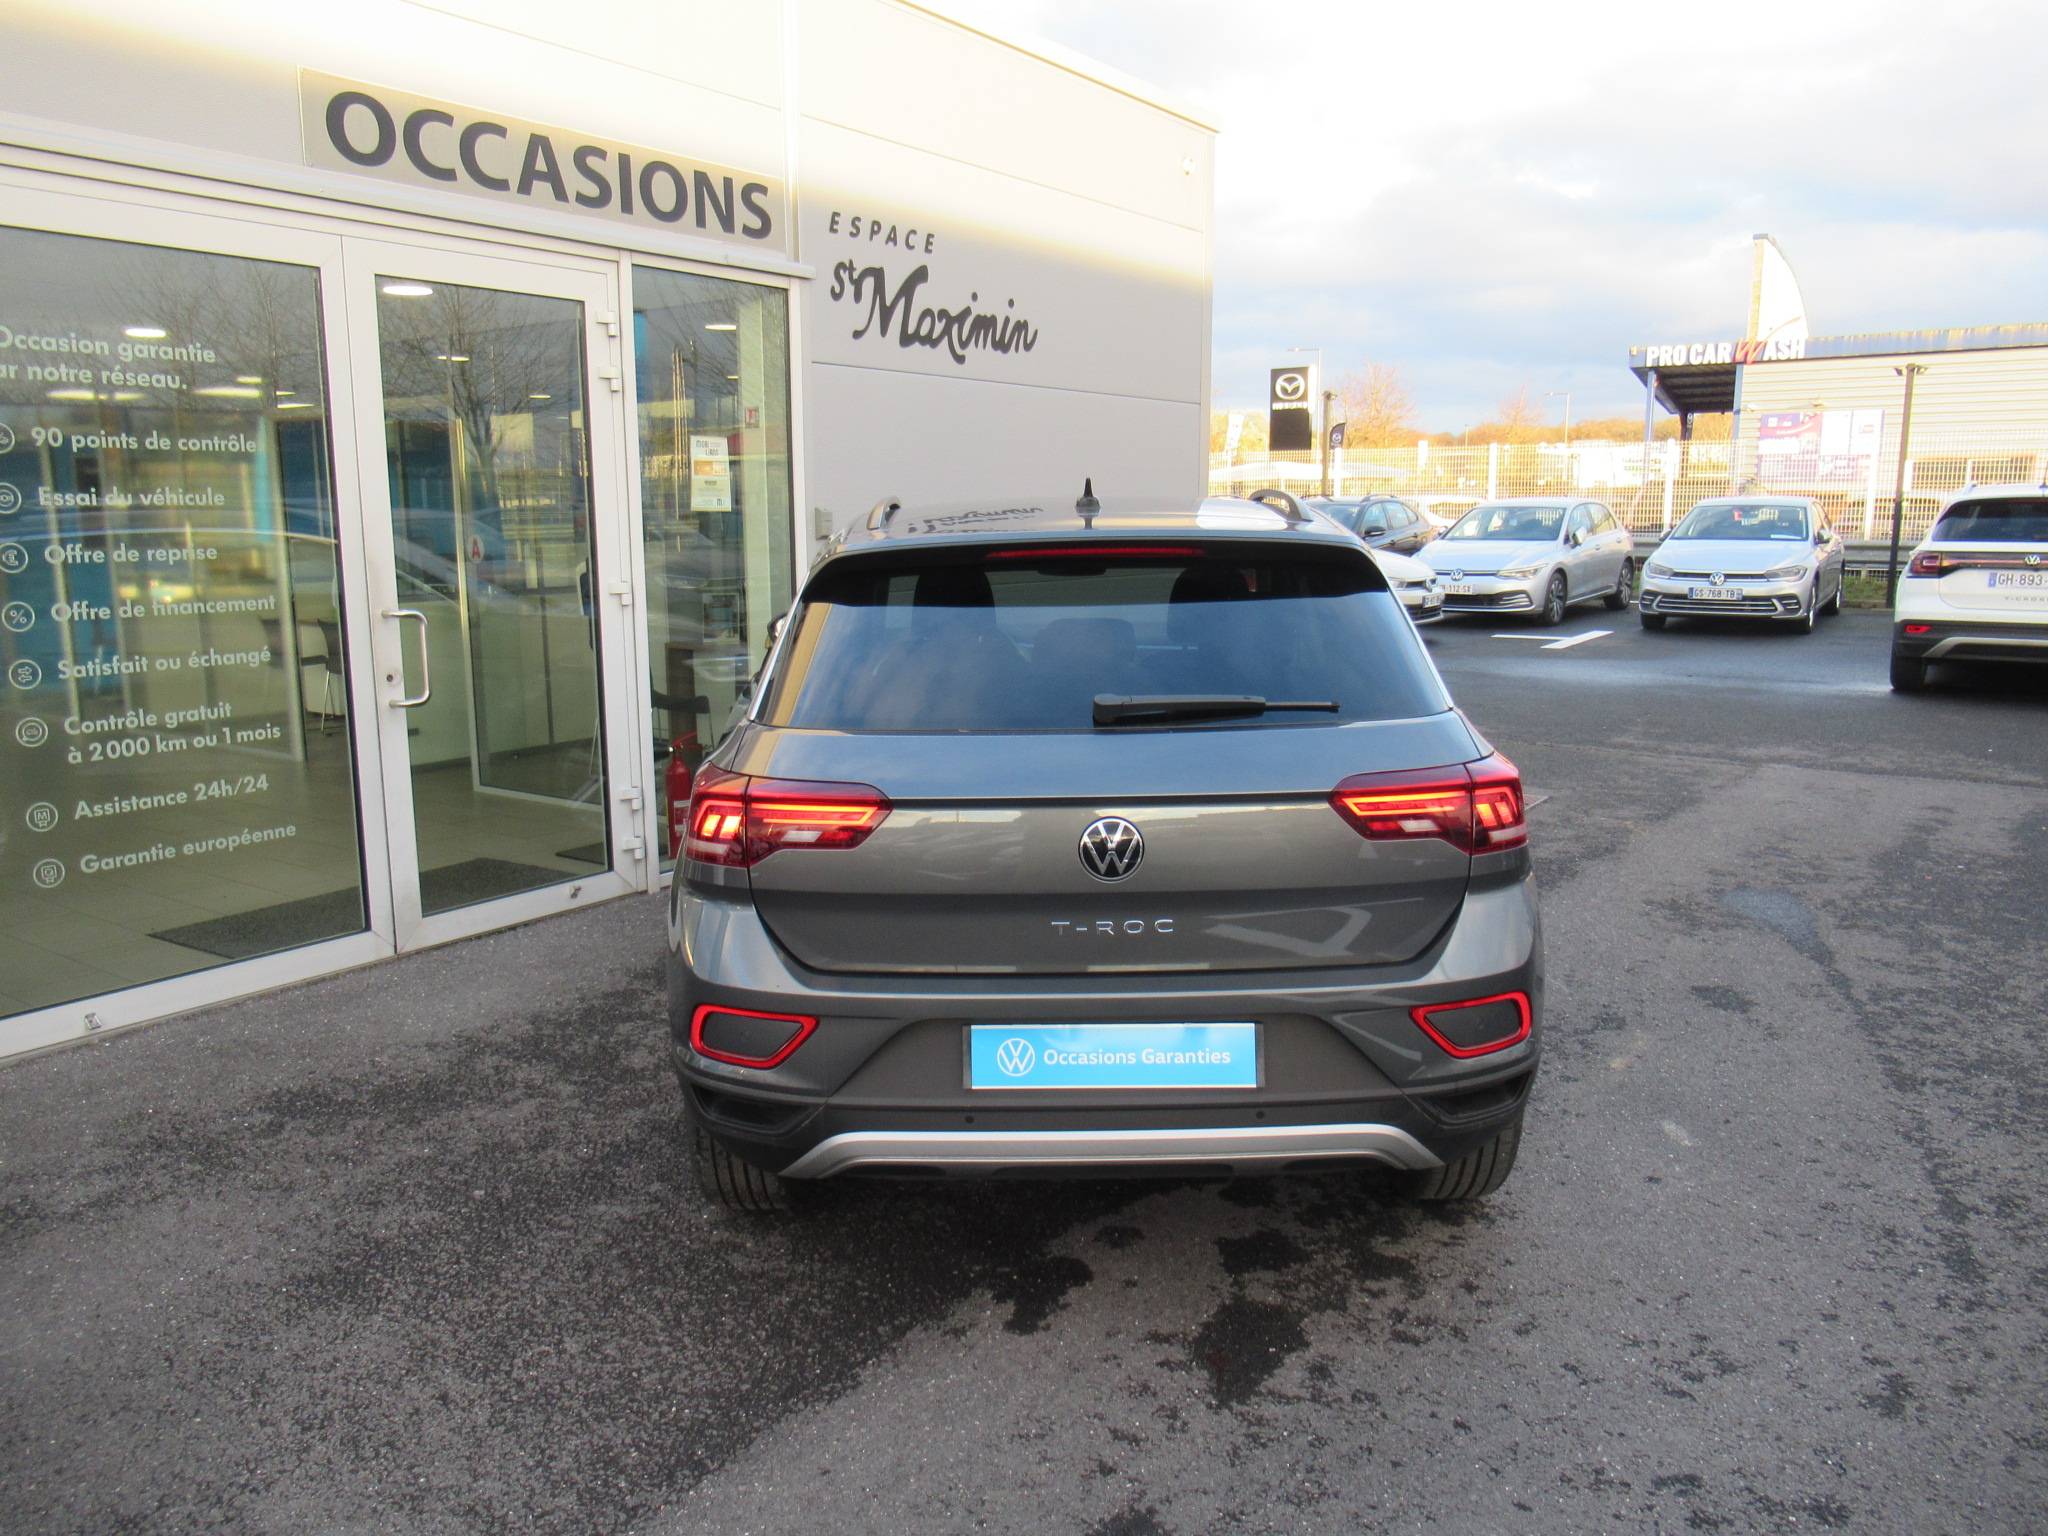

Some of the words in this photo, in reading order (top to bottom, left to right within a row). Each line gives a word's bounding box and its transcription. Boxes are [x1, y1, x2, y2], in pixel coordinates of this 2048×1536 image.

[325, 91, 773, 240] OCCASIONS
[829, 211, 935, 254] ESPACE
[852, 265, 1038, 364] Maximin
[0, 325, 110, 356] Occasion
[118, 343, 216, 363] garantie
[1646, 345, 1690, 367] PRO
[1689, 342, 1732, 366] CAR
[27, 363, 93, 383] notre
[101, 365, 188, 389] réseau.
[31, 427, 64, 447] 90
[71, 431, 138, 452] points
[145, 430, 171, 450] de
[178, 434, 257, 453] contrôle
[38, 487, 97, 506] Essai
[105, 486, 133, 506] du
[139, 487, 225, 506] véhicule
[44, 544, 106, 564] Offre
[112, 543, 139, 563] de
[147, 547, 218, 565] reprise
[51, 600, 111, 622] Offre
[118, 600, 145, 618] de
[152, 595, 276, 616] financement
[57, 655, 149, 679] Satisfait
[155, 656, 181, 670] ou
[188, 645, 271, 668] échangé
[64, 708, 158, 735] Contrôle
[164, 702, 232, 728] gratuit
[67, 745, 82, 764] à
[156, 735, 187, 752] km
[193, 735, 217, 747] ou
[236, 725, 281, 743] mois
[74, 791, 188, 820] Assistance
[194, 774, 270, 801] 24h/24
[80, 844, 177, 874] Garantie
[183, 824, 297, 856] européenne
[1051, 919, 1174, 936] T-ROC
[1043, 1048, 1137, 1066] Occasions
[1141, 1048, 1231, 1065] Garanties
